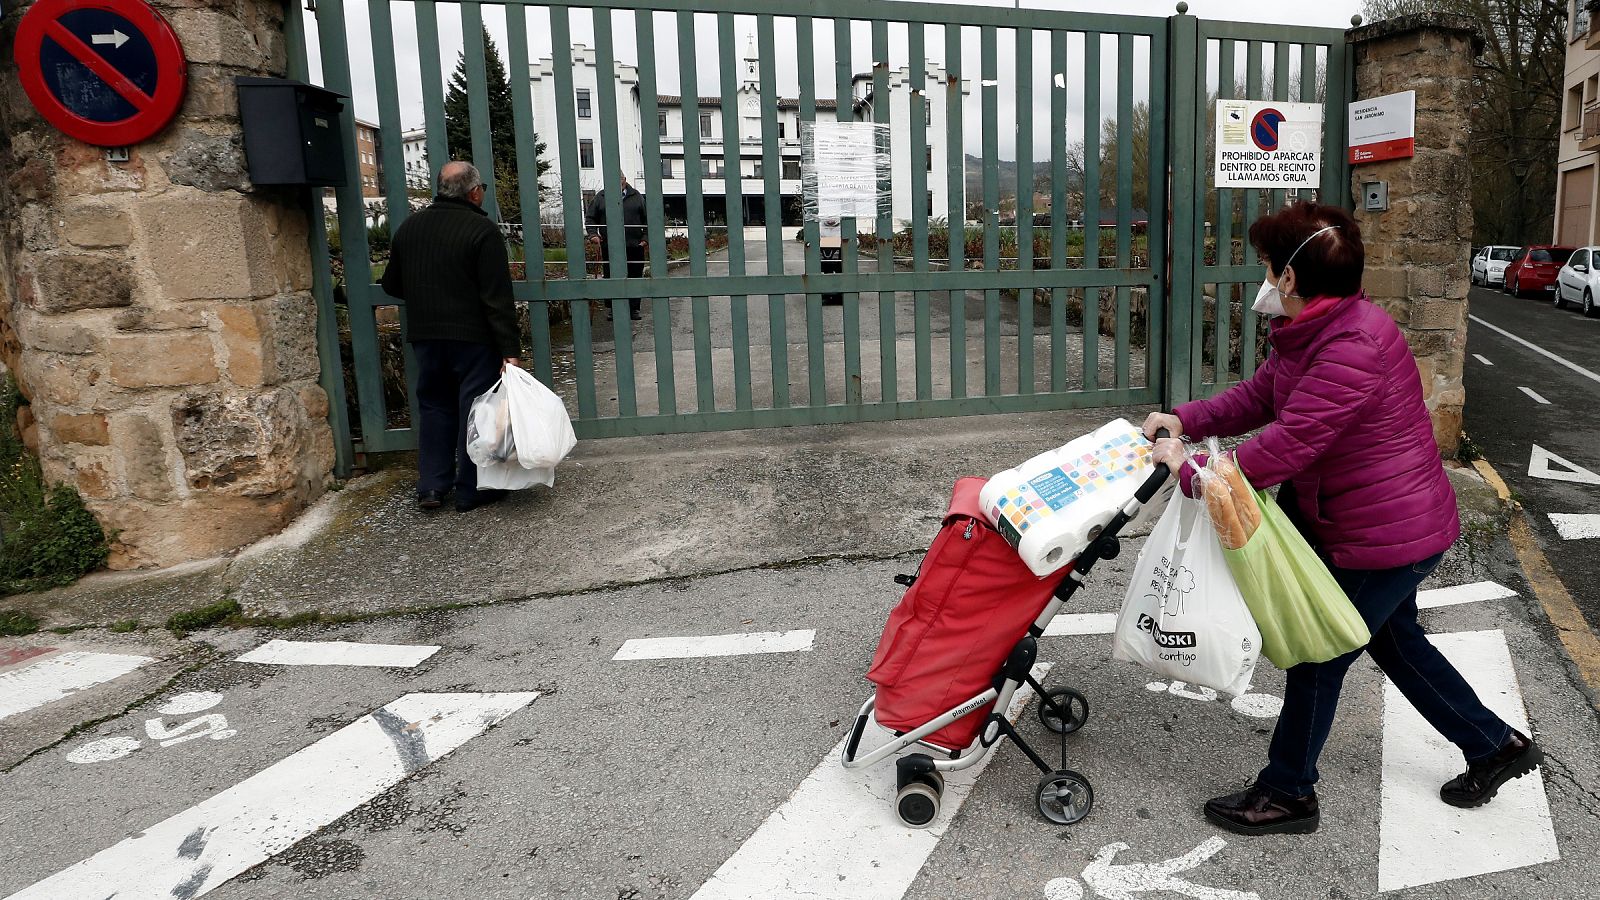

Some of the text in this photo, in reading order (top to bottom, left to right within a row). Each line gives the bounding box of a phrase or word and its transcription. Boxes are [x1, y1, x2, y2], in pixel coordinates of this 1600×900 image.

[1354, 106, 1378, 115] RESIDENCIA
[1222, 152, 1314, 161] PROHIBIDO APARCAR
[1220, 163, 1316, 172] DENTRO DEL RECINTO
[1228, 173, 1307, 182] LLAMAMOS GRUA
[1158, 650, 1197, 666] contigo
[952, 697, 987, 718] playmarket
